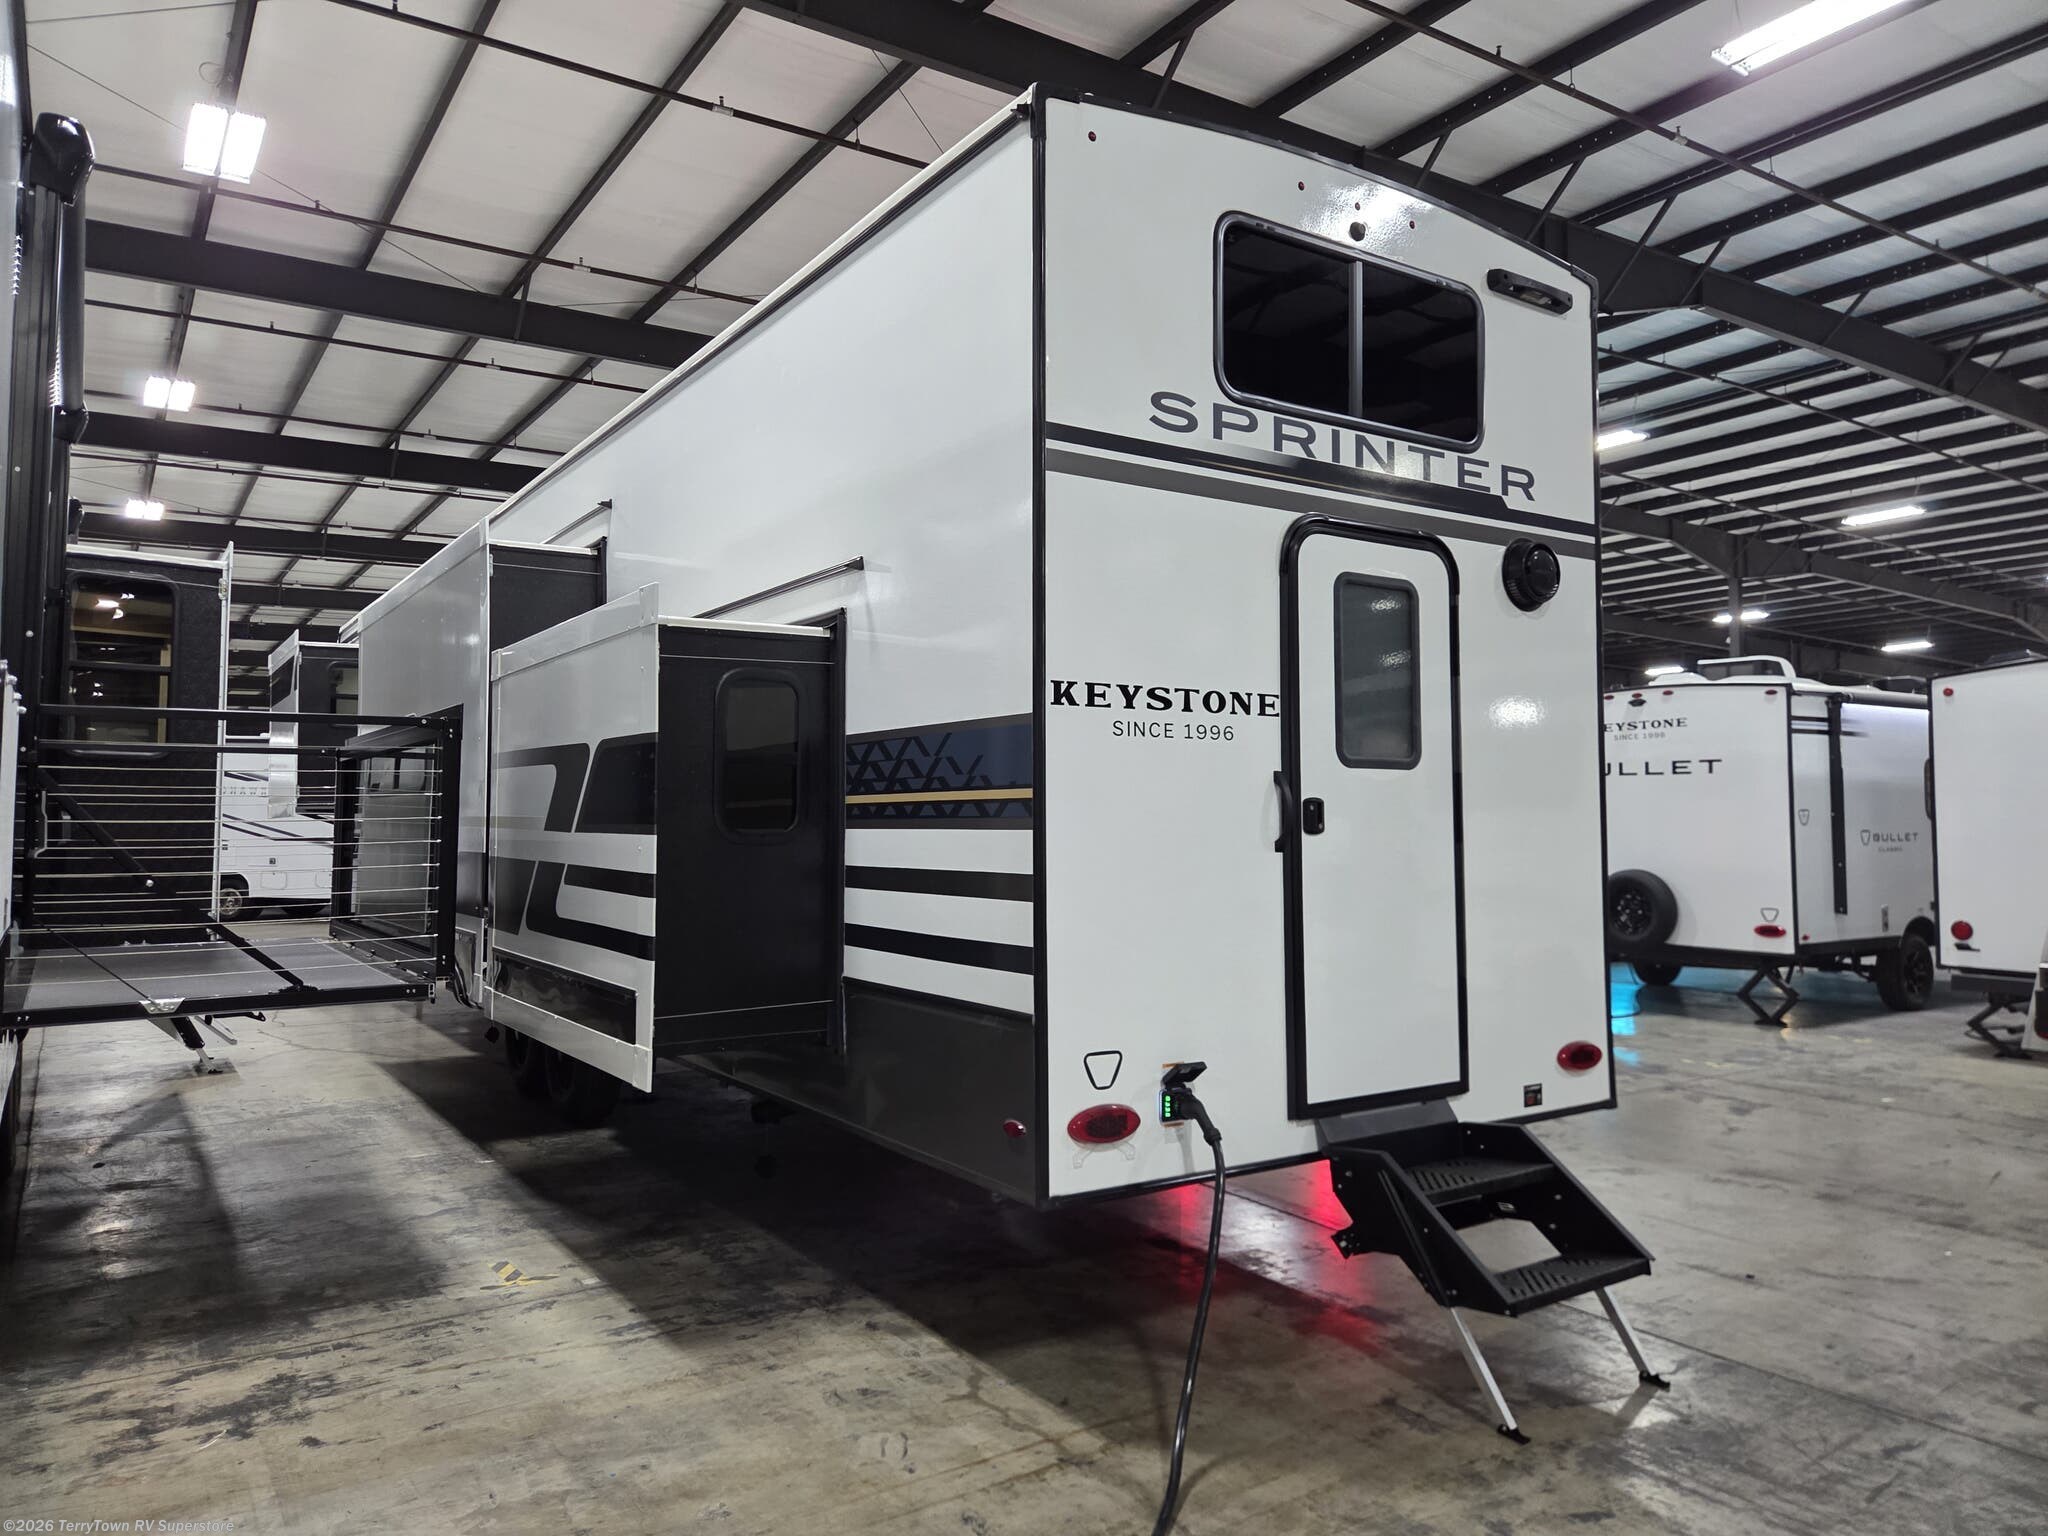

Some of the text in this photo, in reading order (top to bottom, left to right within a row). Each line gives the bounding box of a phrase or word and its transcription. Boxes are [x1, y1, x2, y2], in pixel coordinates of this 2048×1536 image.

[1149, 391, 1536, 502] SPRINTER
[1050, 679, 1280, 718] KEYSTONE
[1112, 720, 1235, 741] SINCE 1996
[1604, 717, 1688, 732] EYSTONE
[1604, 758, 1722, 776] LLET
